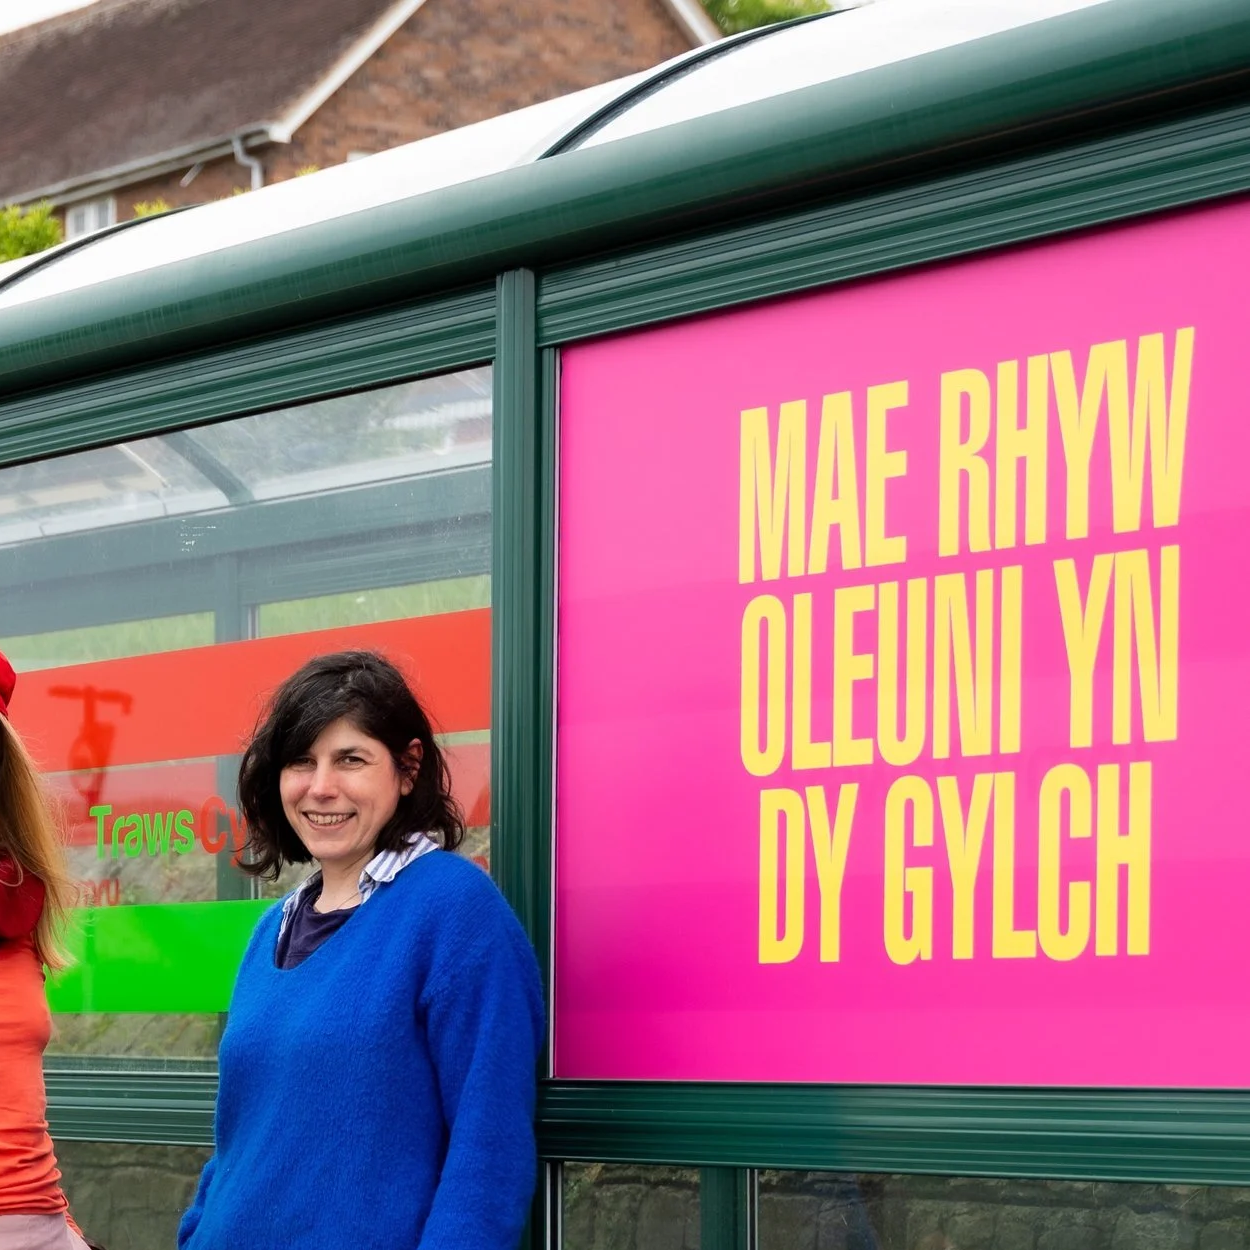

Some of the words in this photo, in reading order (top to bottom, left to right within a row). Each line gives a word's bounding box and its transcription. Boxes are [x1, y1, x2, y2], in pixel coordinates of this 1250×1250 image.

[738, 380, 909, 584] MAE
[938, 326, 1195, 558] RHYW
[740, 565, 1023, 777] OLEUNI
[1053, 544, 1181, 749] YN
[758, 782, 859, 964] DY
[884, 761, 1152, 965] GYLCH
